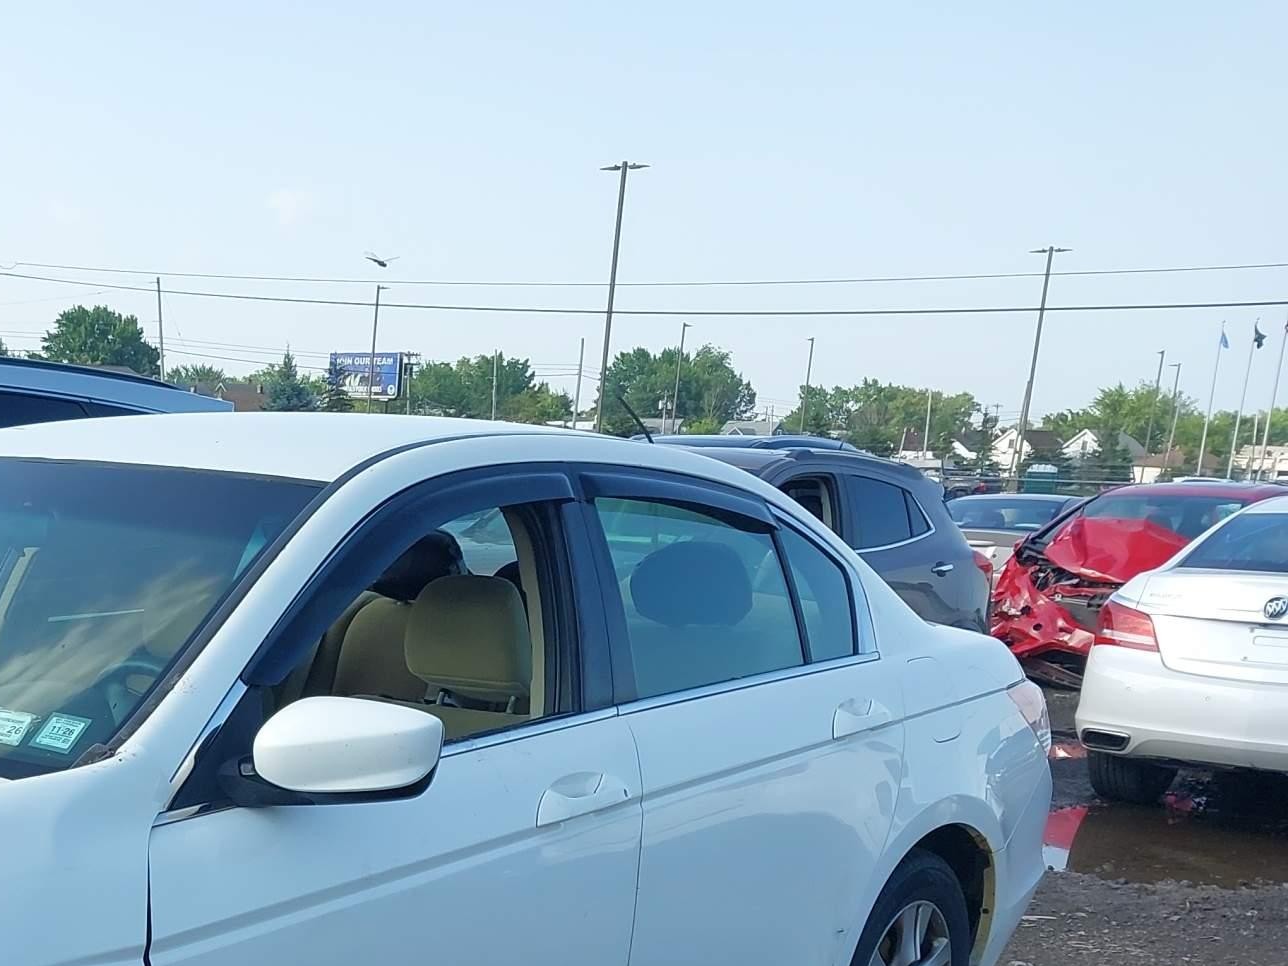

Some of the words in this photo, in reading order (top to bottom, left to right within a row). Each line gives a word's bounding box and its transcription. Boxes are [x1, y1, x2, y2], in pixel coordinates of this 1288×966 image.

[354, 357, 371, 365] OUR
[373, 357, 394, 366] TEAM
[6, 725, 24, 736] 26
[50, 725, 76, 737] 11-26
